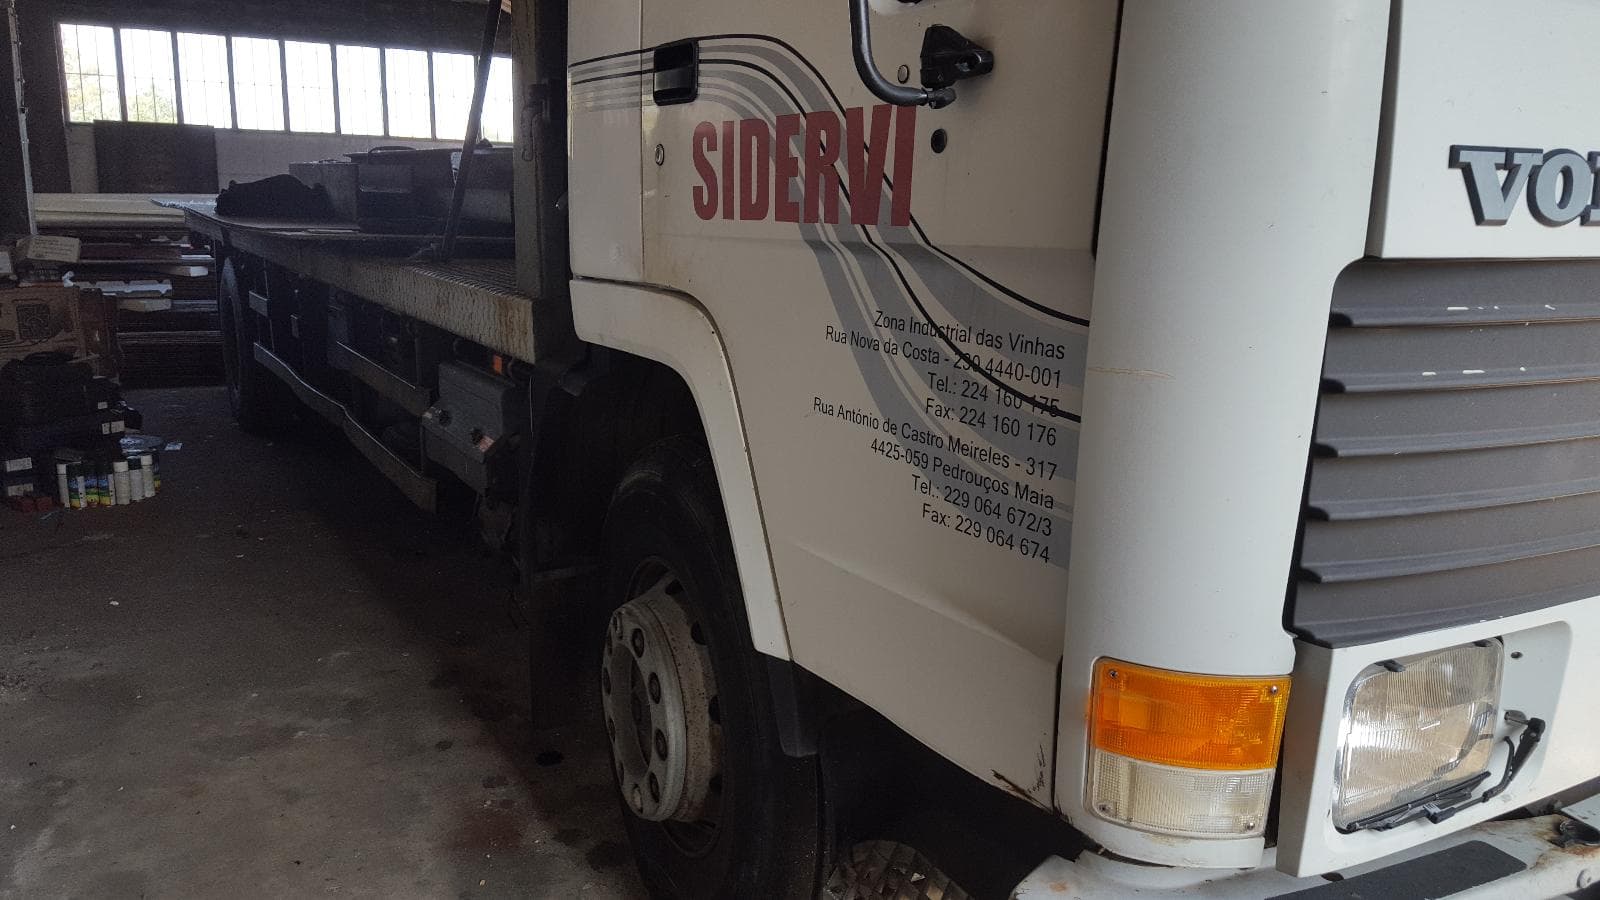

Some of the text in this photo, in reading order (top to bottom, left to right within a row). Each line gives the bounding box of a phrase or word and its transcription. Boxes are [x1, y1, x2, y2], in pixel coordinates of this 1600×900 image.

[693, 104, 916, 226] SIDERVI
[1448, 145, 1600, 227] VO
[825, 325, 847, 345] Rua
[850, 330, 880, 352] Nova
[883, 338, 898, 356] da
[902, 341, 940, 365] Costa
[985, 358, 1061, 389] 4440-001
[874, 311, 1065, 360] Zona Industrial das Vinhas
[925, 397, 1057, 447] Fax: 224 160 176
[927, 371, 957, 395] Tel.:
[960, 379, 988, 402] 224
[995, 385, 1023, 410] 160
[814, 396, 834, 416] Rua
[837, 404, 879, 430] António
[882, 418, 898, 436] de
[901, 422, 944, 449] Castro
[948, 435, 1010, 468] Meireles
[1025, 457, 1058, 481] 317
[871, 438, 1055, 510] 4425-059 Pedrouços Maia
[911, 473, 1053, 537] Tel.: 229 064 672/3
[922, 502, 1051, 564] Fax: 229 064 674
